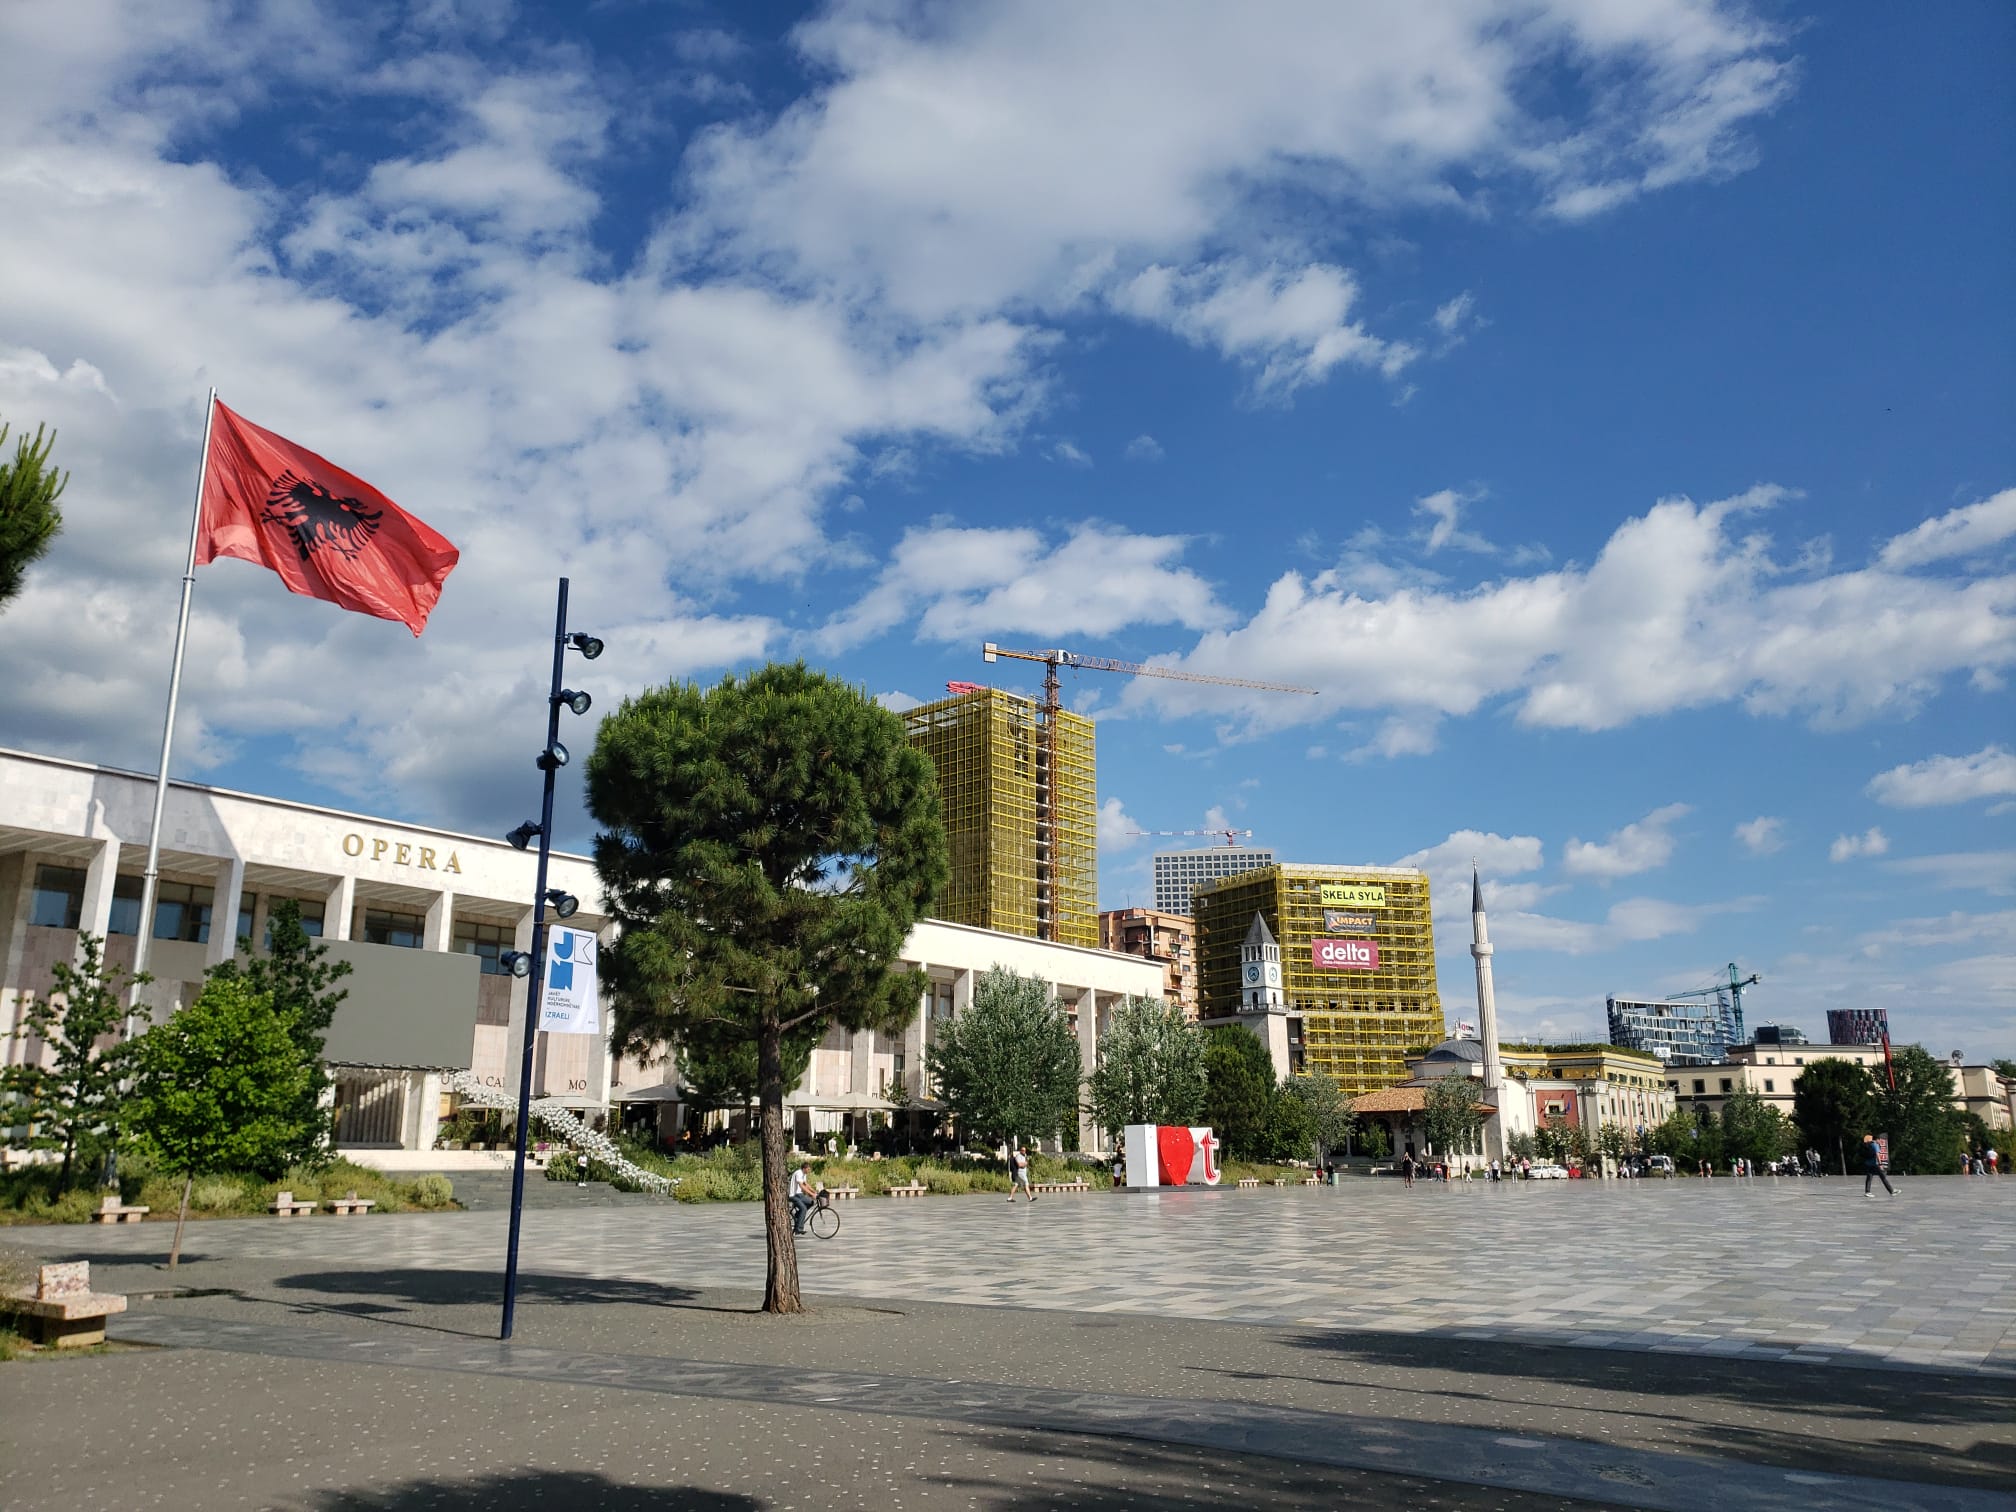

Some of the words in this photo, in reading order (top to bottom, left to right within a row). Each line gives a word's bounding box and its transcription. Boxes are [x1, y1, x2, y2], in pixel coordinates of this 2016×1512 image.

[342, 833, 462, 874] OPERA
[1322, 890, 1355, 900] SKELA
[1358, 891, 1384, 901] SYLA
[1336, 916, 1374, 926] IMPACT
[1321, 942, 1371, 961] delta
[545, 1011, 570, 1020] IZRAELI
